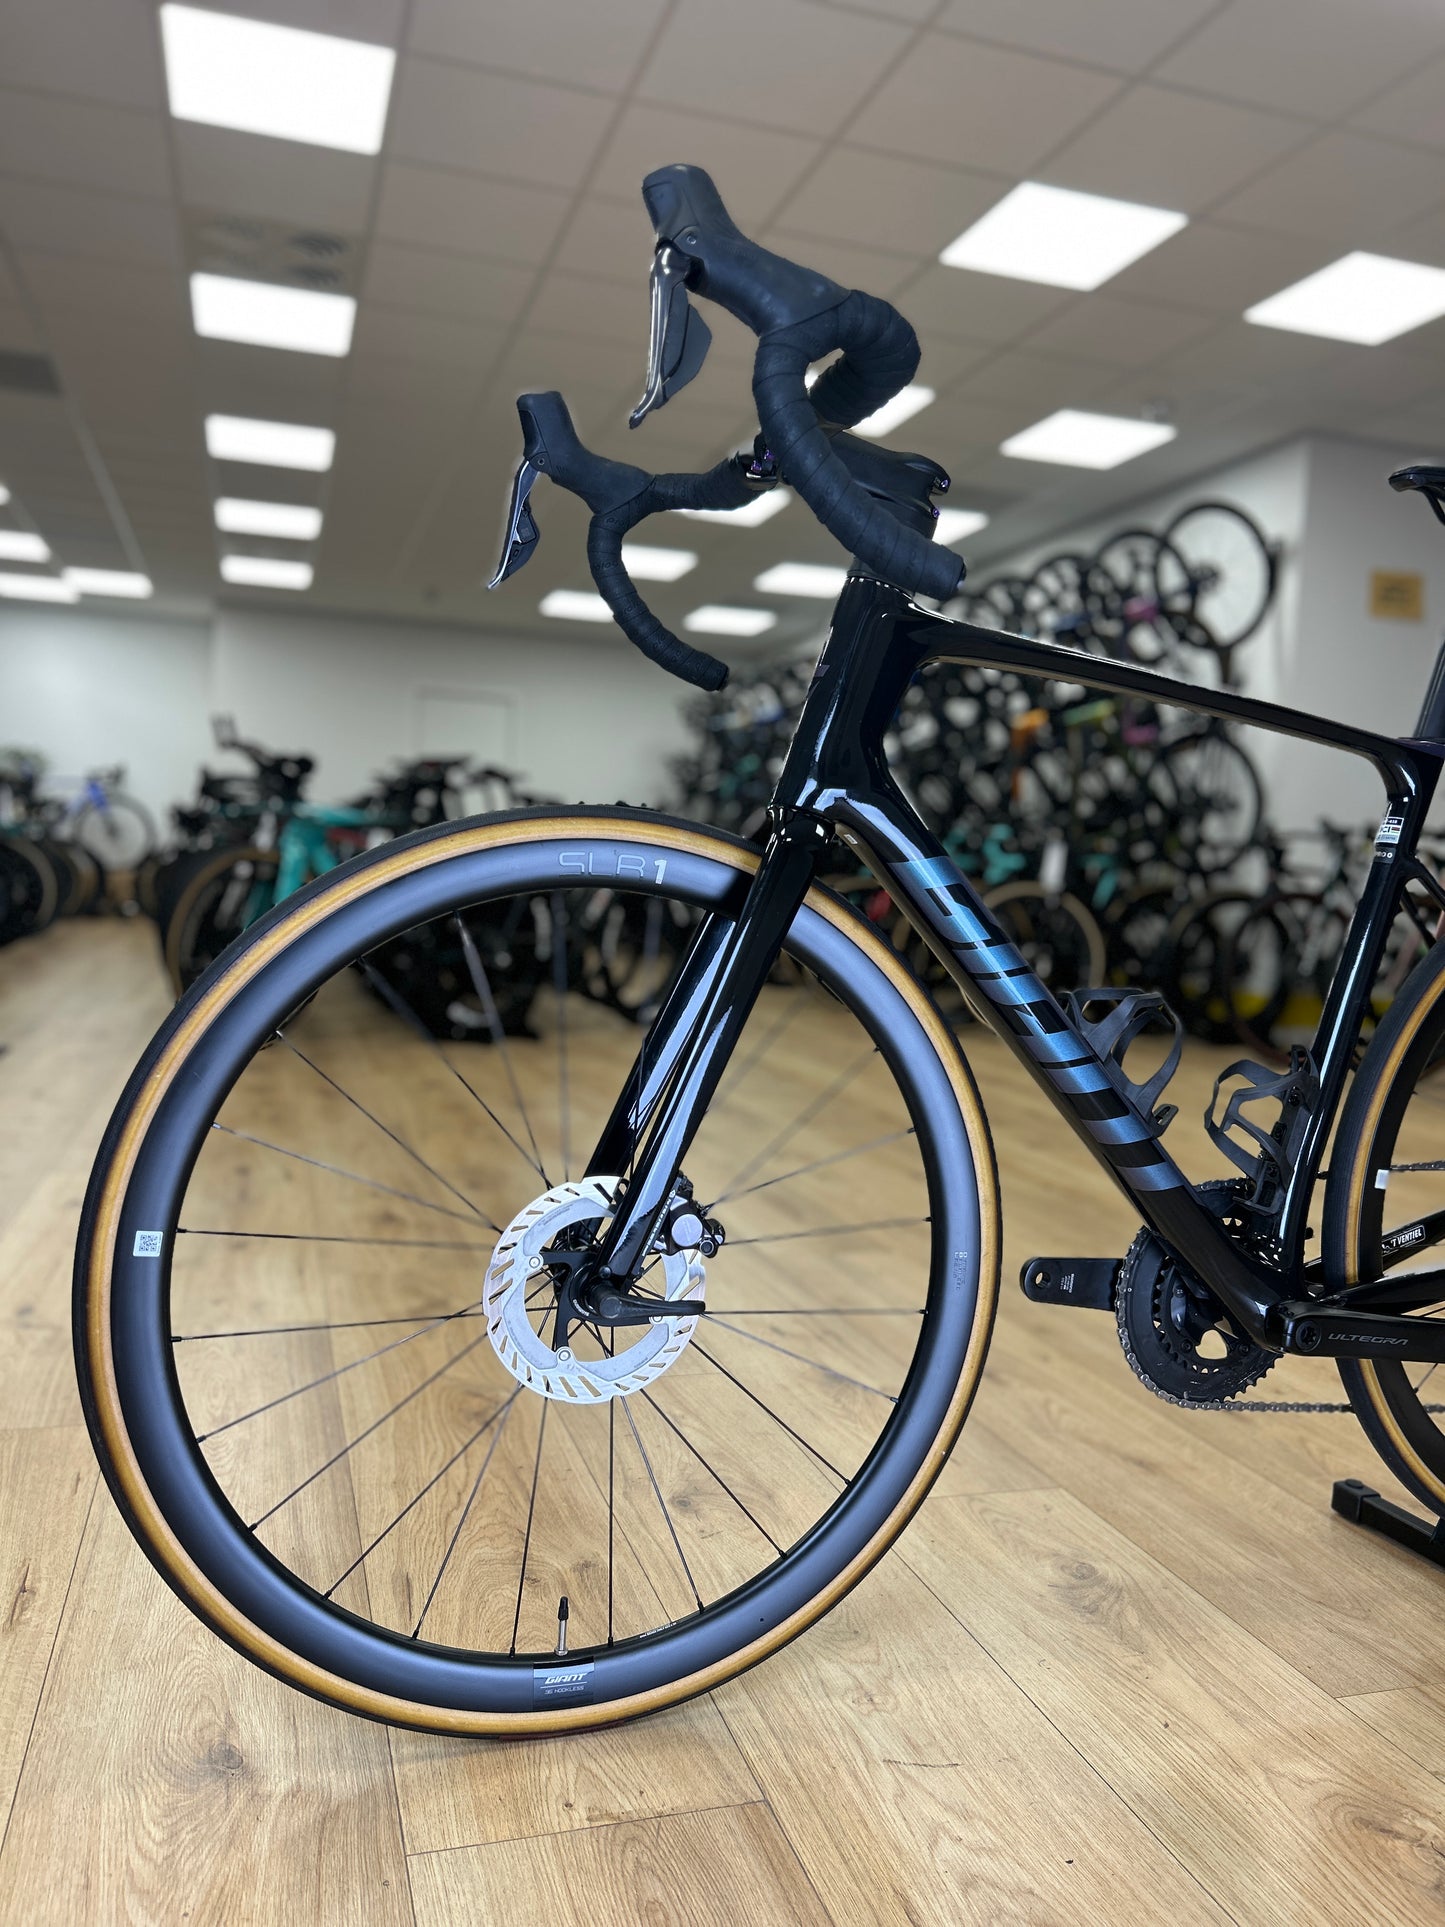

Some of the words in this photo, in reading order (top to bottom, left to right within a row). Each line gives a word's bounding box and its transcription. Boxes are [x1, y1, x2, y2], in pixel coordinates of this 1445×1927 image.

[886, 855, 1189, 1192] GIANT
[1397, 1227, 1423, 1245] VENTIEL
[1328, 1332, 1409, 1346] ULTEGRA
[544, 1672, 588, 1685] GIANT
